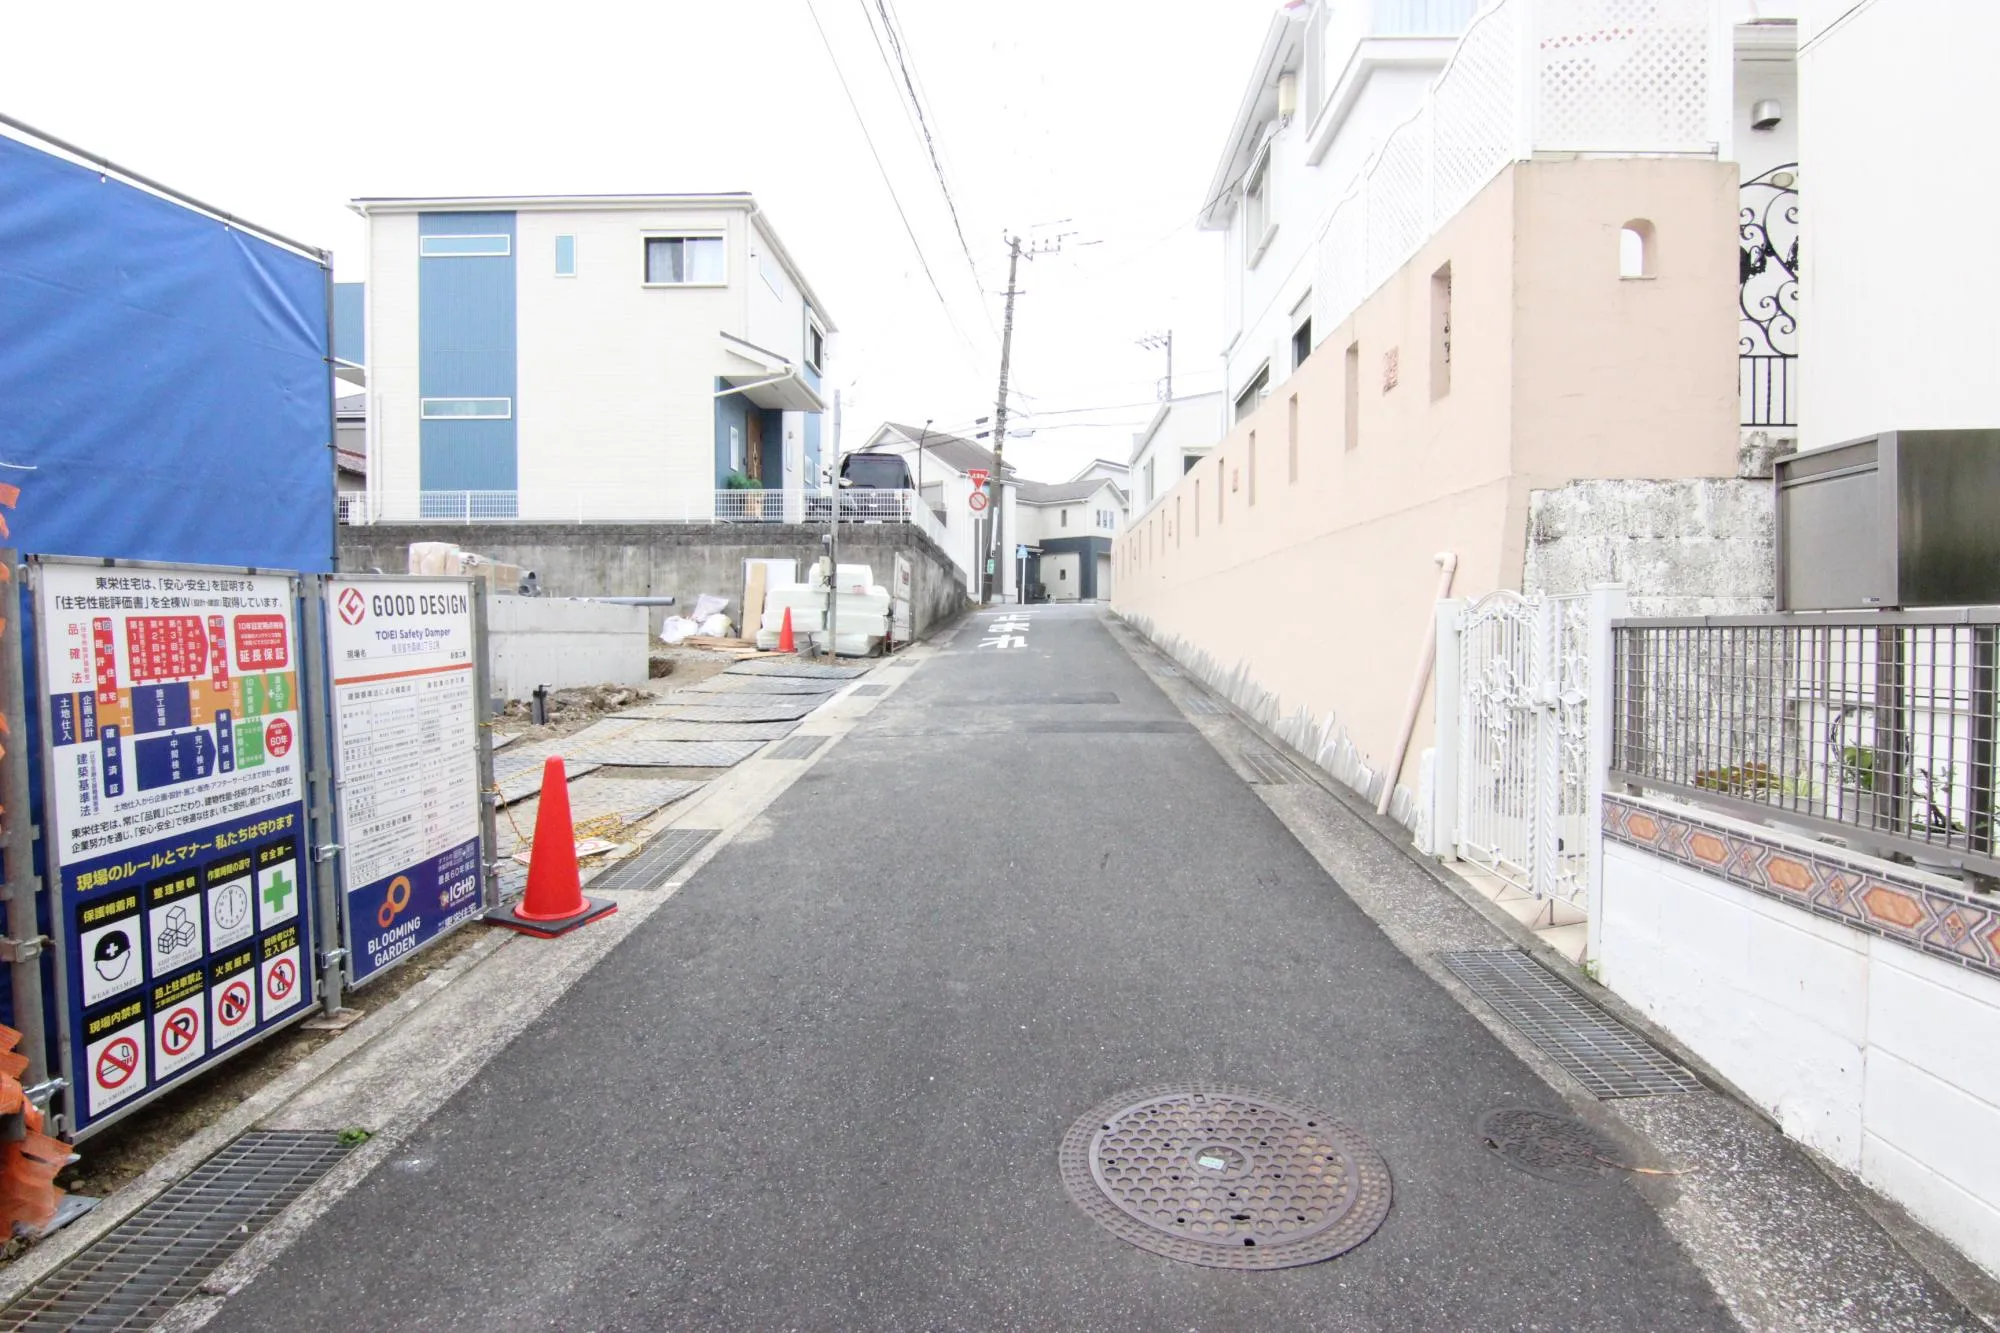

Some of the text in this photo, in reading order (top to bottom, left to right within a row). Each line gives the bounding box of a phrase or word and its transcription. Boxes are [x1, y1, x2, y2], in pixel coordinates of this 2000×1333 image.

[96, 576, 254, 592] 東栄住宅は、「安心・安全」を証明する
[372, 592, 467, 617] GOOD DESIGN
[399, 629, 423, 640] Safety
[425, 628, 451, 641] Damper
[68, 623, 82, 684] 品確法
[239, 647, 285, 663] 延長保証
[346, 649, 367, 659] 現場名
[60, 698, 72, 741] 土地仕入
[82, 695, 94, 738] 企画・設計
[194, 735, 205, 775] 完了検査
[219, 712, 231, 770] 検査済証
[105, 728, 119, 794] 確認済証
[170, 739, 180, 780] 中間検査
[77, 754, 91, 817] 建築基準法
[76, 813, 294, 892] 現場のルールとマナー 私たちは守ります
[260, 845, 292, 863] 安全第一
[83, 896, 136, 924] 保護帽着用
[264, 937, 296, 958] 立入禁止
[367, 916, 421, 955] BLOOMING
[374, 934, 416, 967] GARDEN
[215, 952, 251, 978] 火気厳禁
[154, 970, 203, 1000] 路上駐車禁止
[88, 1001, 142, 1034] 現場内禁煙
